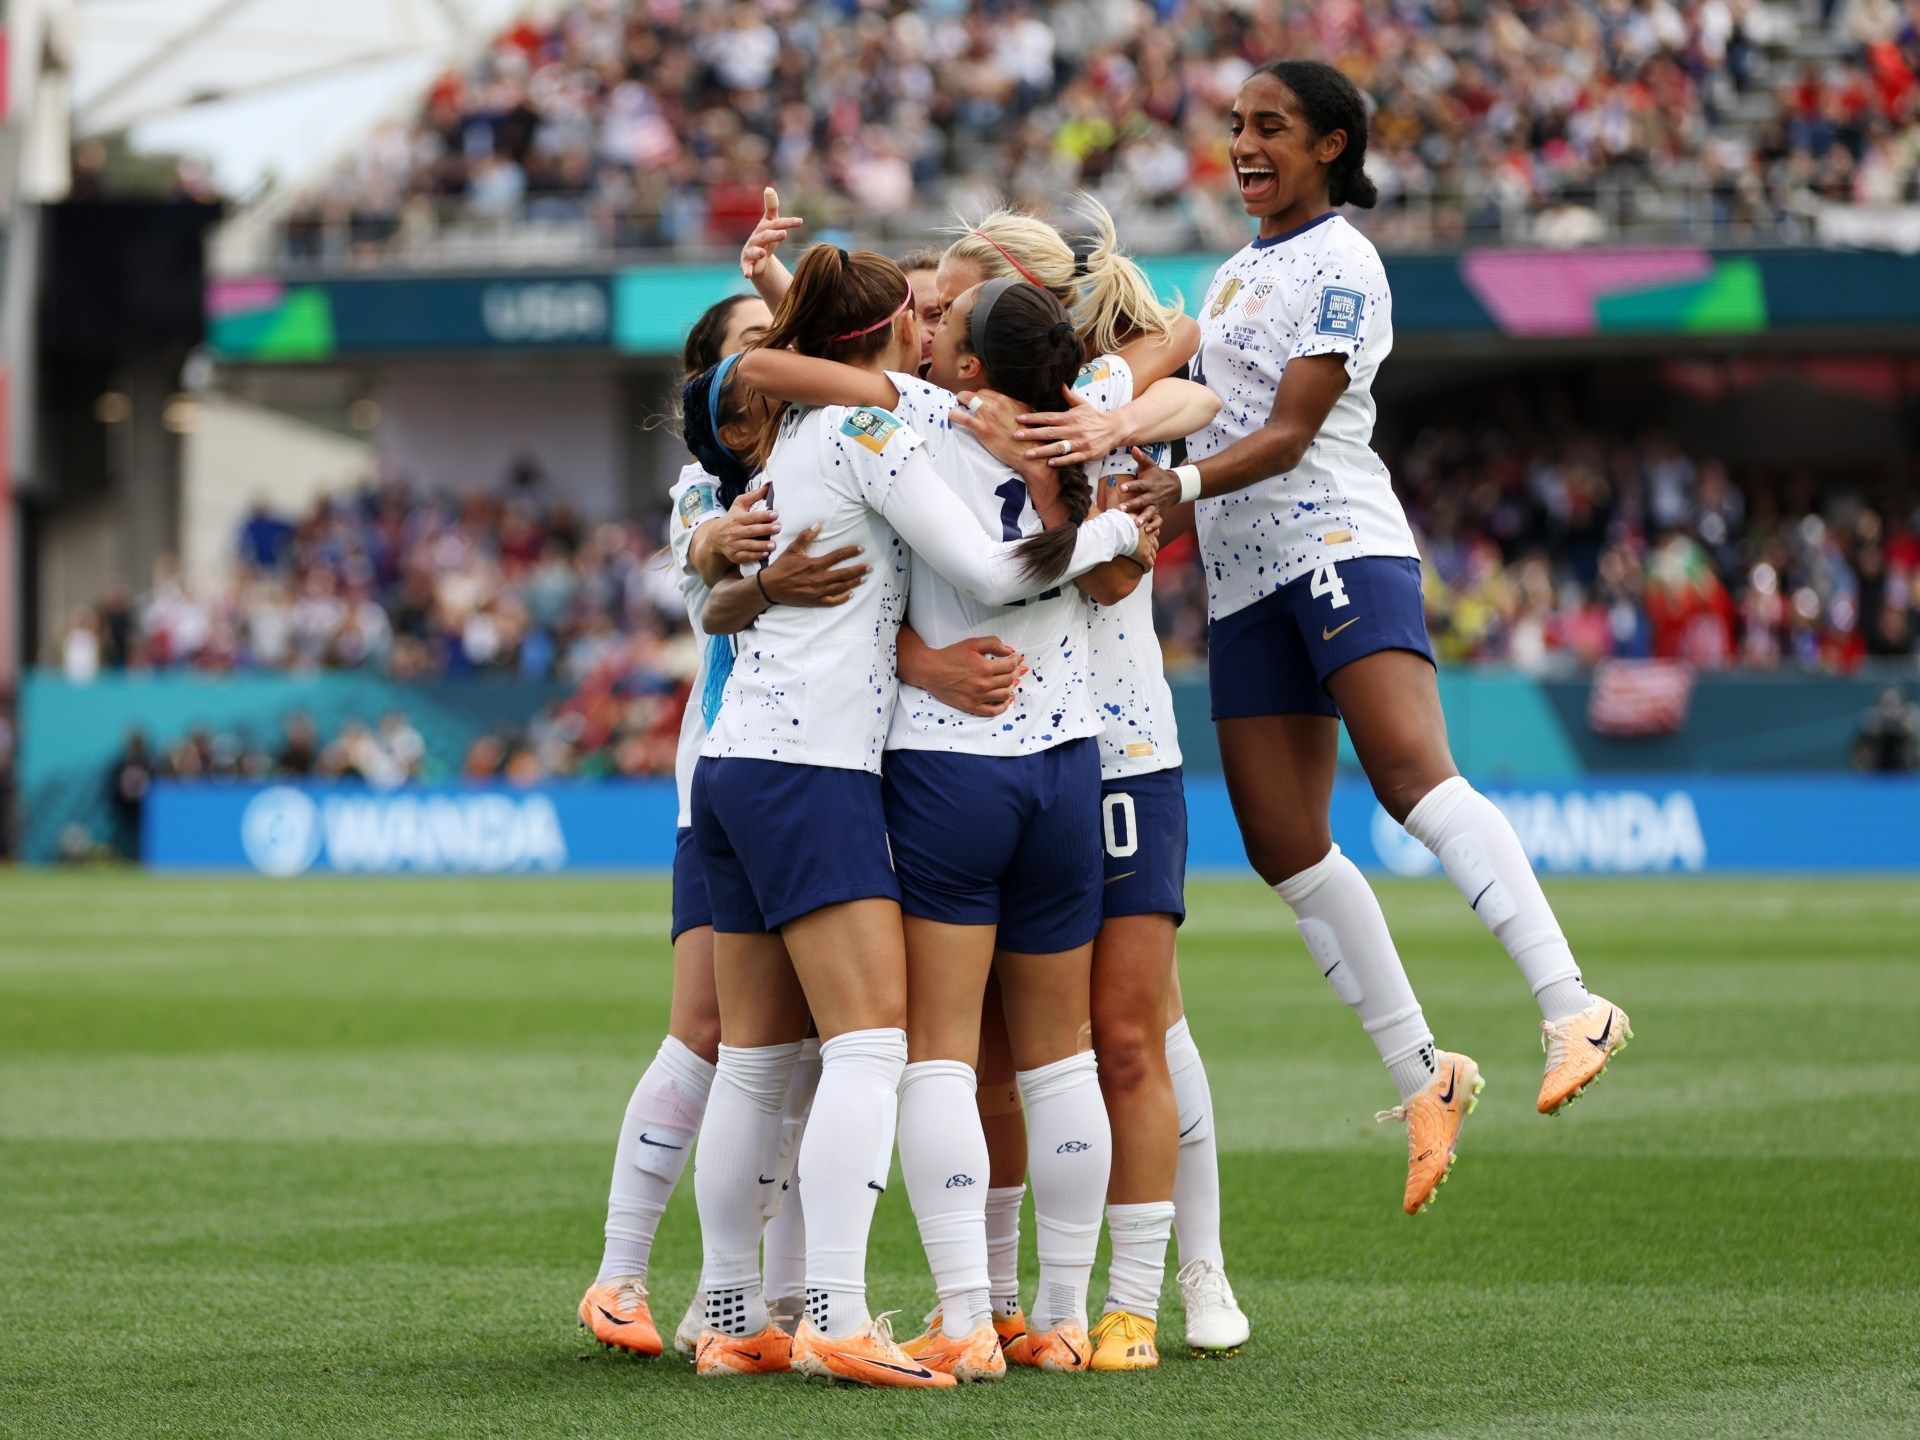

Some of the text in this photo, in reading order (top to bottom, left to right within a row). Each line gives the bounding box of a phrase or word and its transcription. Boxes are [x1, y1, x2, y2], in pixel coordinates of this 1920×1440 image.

[1254, 284, 1273, 299] USA
[1330, 294, 1356, 306] FOOTBALL
[1329, 301, 1356, 314] UNITES
[1310, 563, 1350, 610] 4
[322, 793, 569, 873] WANDA
[1102, 792, 1138, 857] 0
